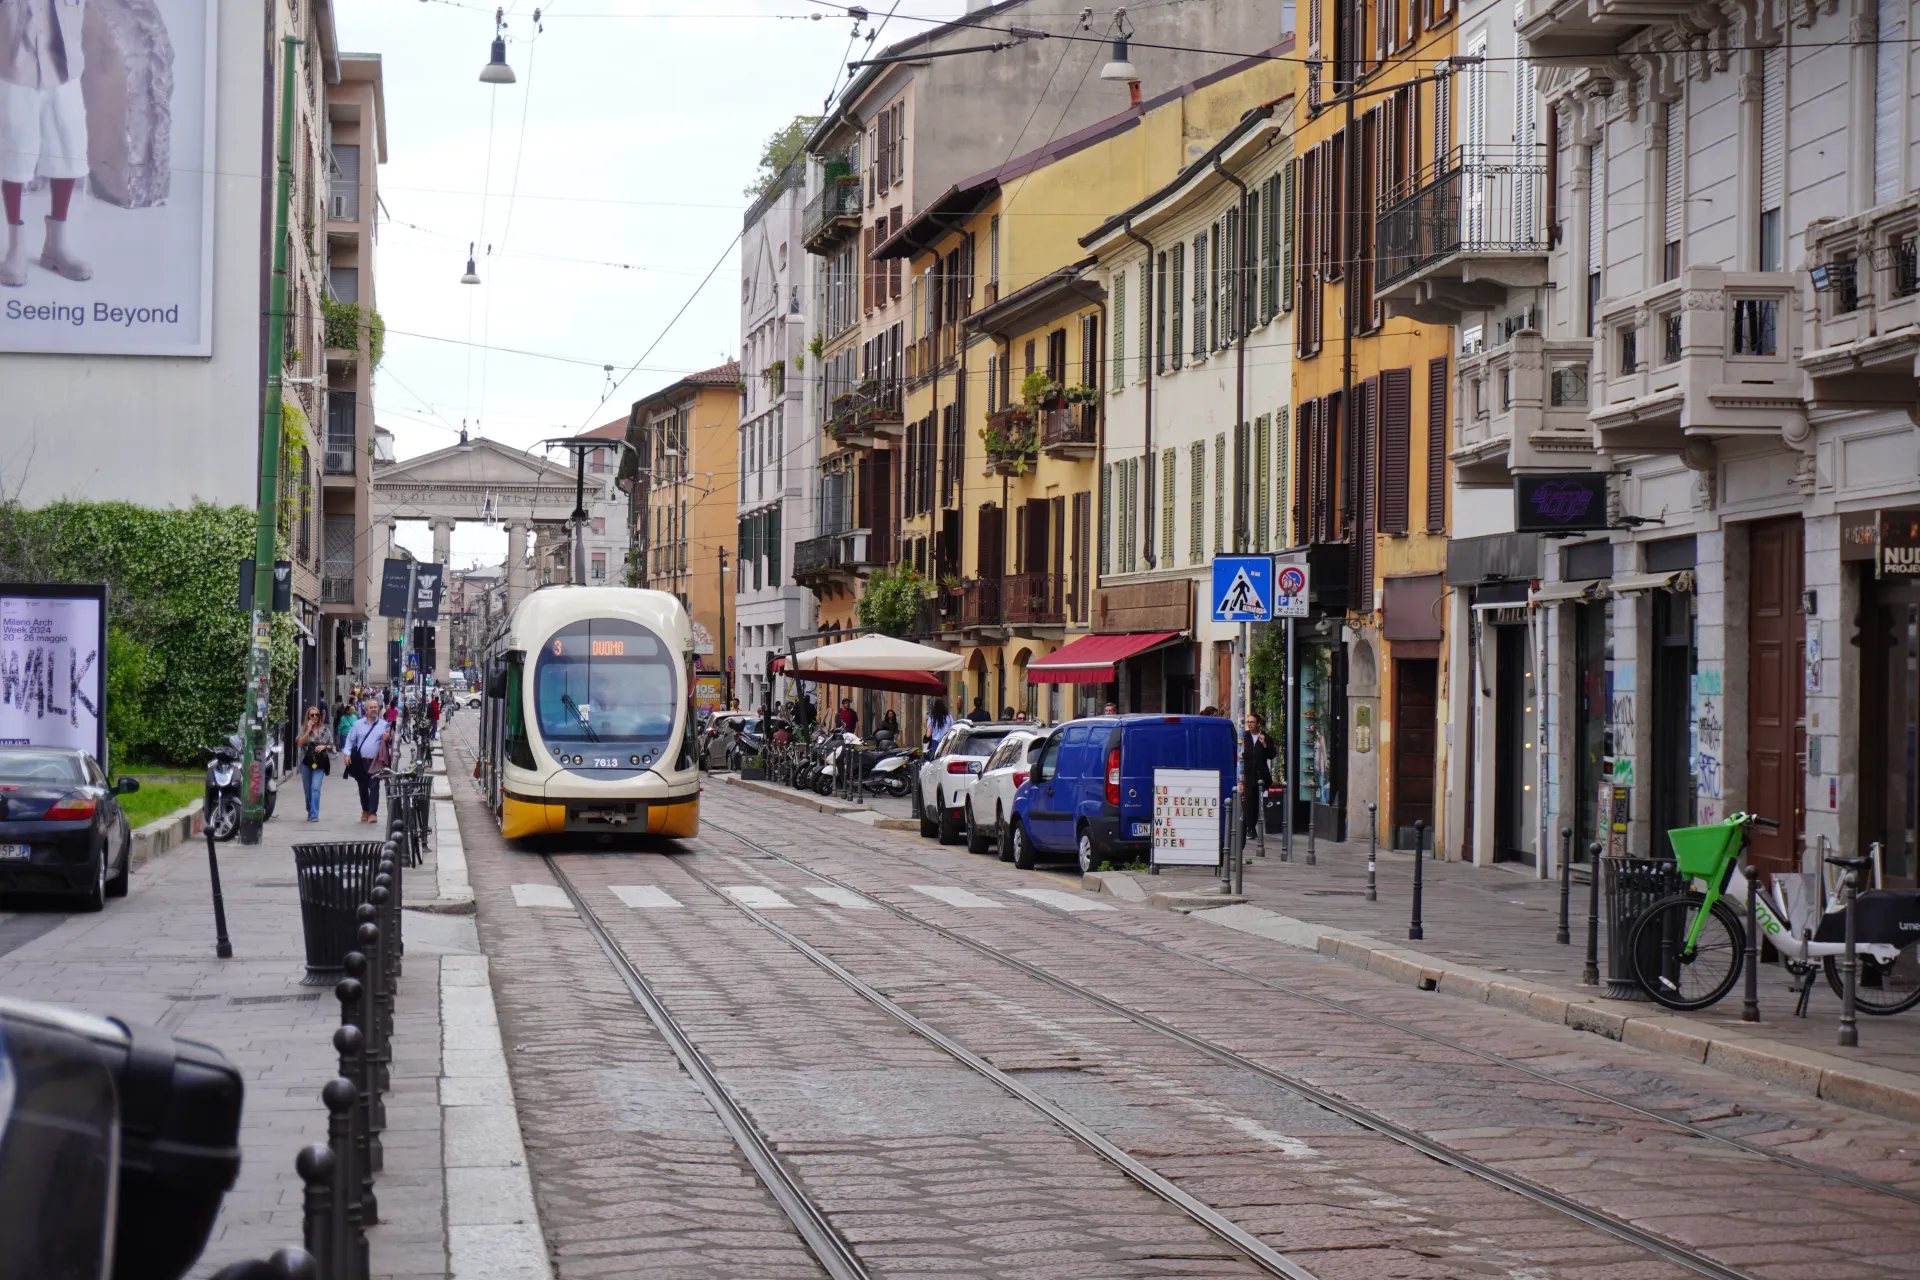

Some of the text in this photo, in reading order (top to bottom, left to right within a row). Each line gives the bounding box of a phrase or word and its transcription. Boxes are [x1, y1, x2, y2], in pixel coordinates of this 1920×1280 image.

[6, 299, 179, 327] Seeing Beyond
[1884, 564, 1920, 574] PROJE
[1281, 597, 1288, 605] P
[3, 618, 53, 627] Milano Arch
[3, 626, 52, 635] Week 2024
[3, 633, 15, 642] 20
[23, 633, 35, 642] 26
[36, 634, 68, 644] maggio
[553, 640, 624, 656] 3 DUOMO
[0, 647, 98, 729] WALK
[594, 758, 618, 767] 7613
[1155, 786, 1168, 795] LO
[1157, 796, 1217, 807] SPECCHIO
[1154, 818, 1171, 827] WE
[1138, 825, 1148, 834] DN
[1155, 828, 1176, 837] ARE
[1155, 838, 1185, 847] OPEN
[0, 845, 22, 857] 5PJ
[1752, 901, 1781, 935] ime
